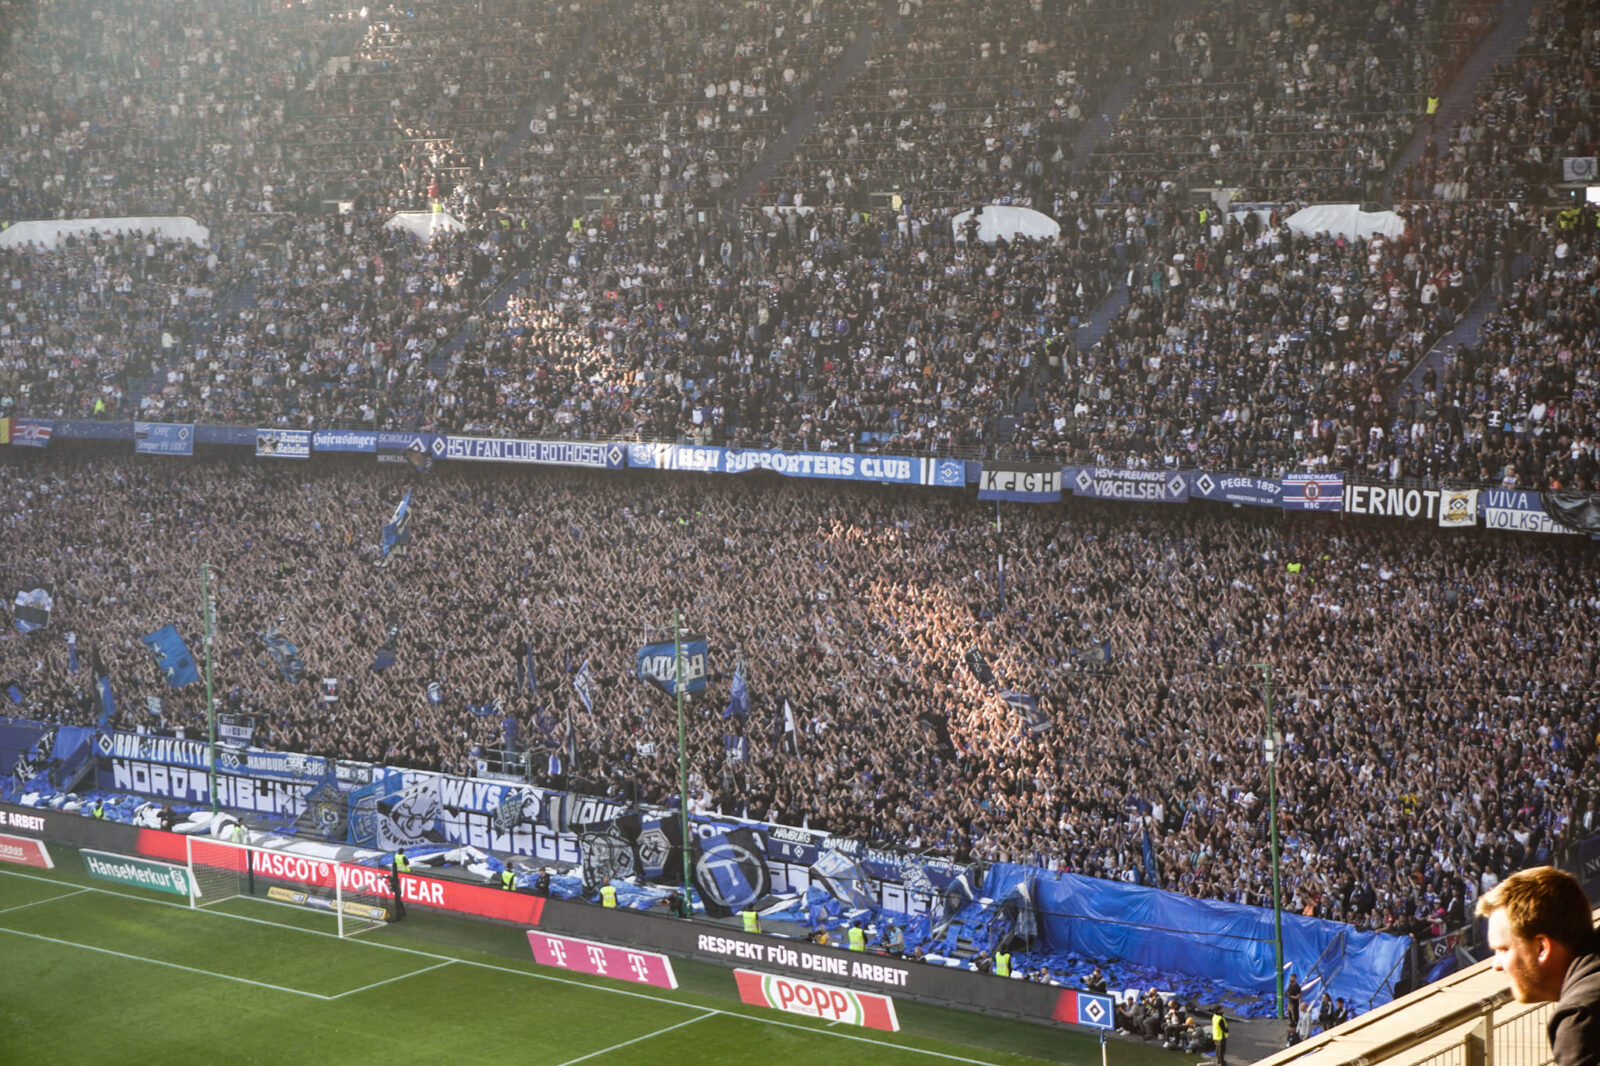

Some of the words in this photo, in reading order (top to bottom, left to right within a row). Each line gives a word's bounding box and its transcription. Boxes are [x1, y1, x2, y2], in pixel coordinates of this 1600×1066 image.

[447, 438, 471, 457] HSV
[475, 440, 500, 459] FAN
[504, 441, 536, 462] CLUB
[541, 443, 607, 466] ROTHOSEN
[679, 447, 720, 471] HSV
[725, 450, 856, 477] SUPPORTERS
[860, 458, 911, 479] CLUB
[1094, 467, 1167, 482] HSV-FREUNDE
[1220, 478, 1253, 489] PEGEL
[1256, 479, 1282, 495] 1887
[1093, 479, 1167, 499] VØGELSEN
[1489, 490, 1528, 510] VIVA
[1342, 485, 1440, 519] IERNOT
[1488, 510, 1576, 534] VOLKSPA
[113, 733, 140, 758] IRON
[9, 813, 45, 832] ARBEIT
[773, 827, 812, 845] HAMBURG
[87, 856, 170, 887] HanseMerkur
[334, 864, 446, 905] WORKEAR
[698, 933, 764, 959] RESPEKT
[767, 943, 798, 967] FÜR
[801, 952, 848, 976] DEINE
[851, 961, 908, 986] ARBEIT
